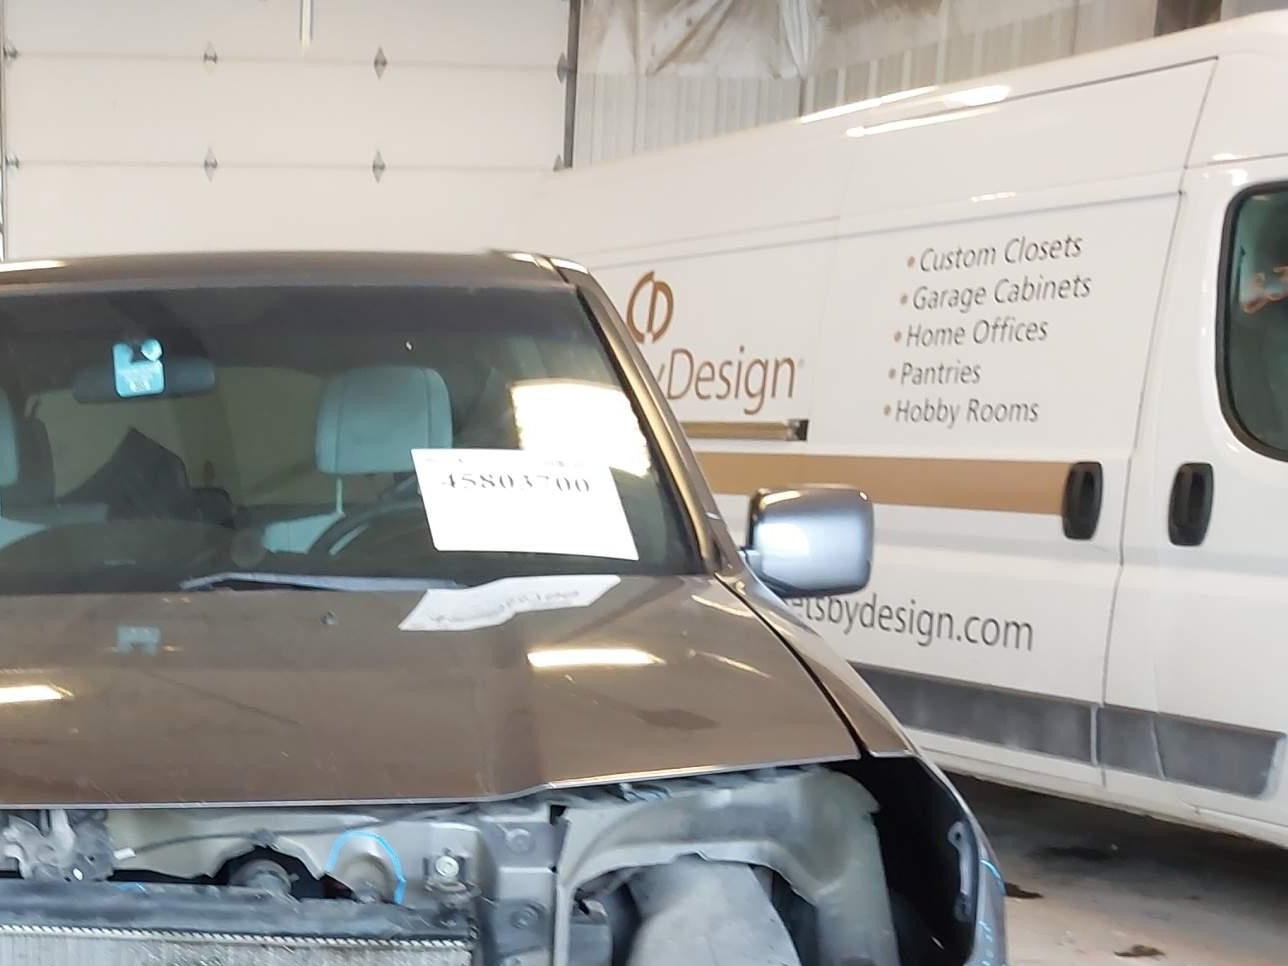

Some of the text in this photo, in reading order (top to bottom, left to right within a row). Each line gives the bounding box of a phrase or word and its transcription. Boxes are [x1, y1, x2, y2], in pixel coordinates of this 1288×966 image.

[920, 235, 1084, 272] Custom Closets
[912, 274, 1092, 314] Garage Cabinets
[906, 316, 1049, 348] Home Offices
[656, 345, 796, 416] Design
[900, 359, 981, 386] Pantries
[895, 397, 1040, 429] Hobby Rooms
